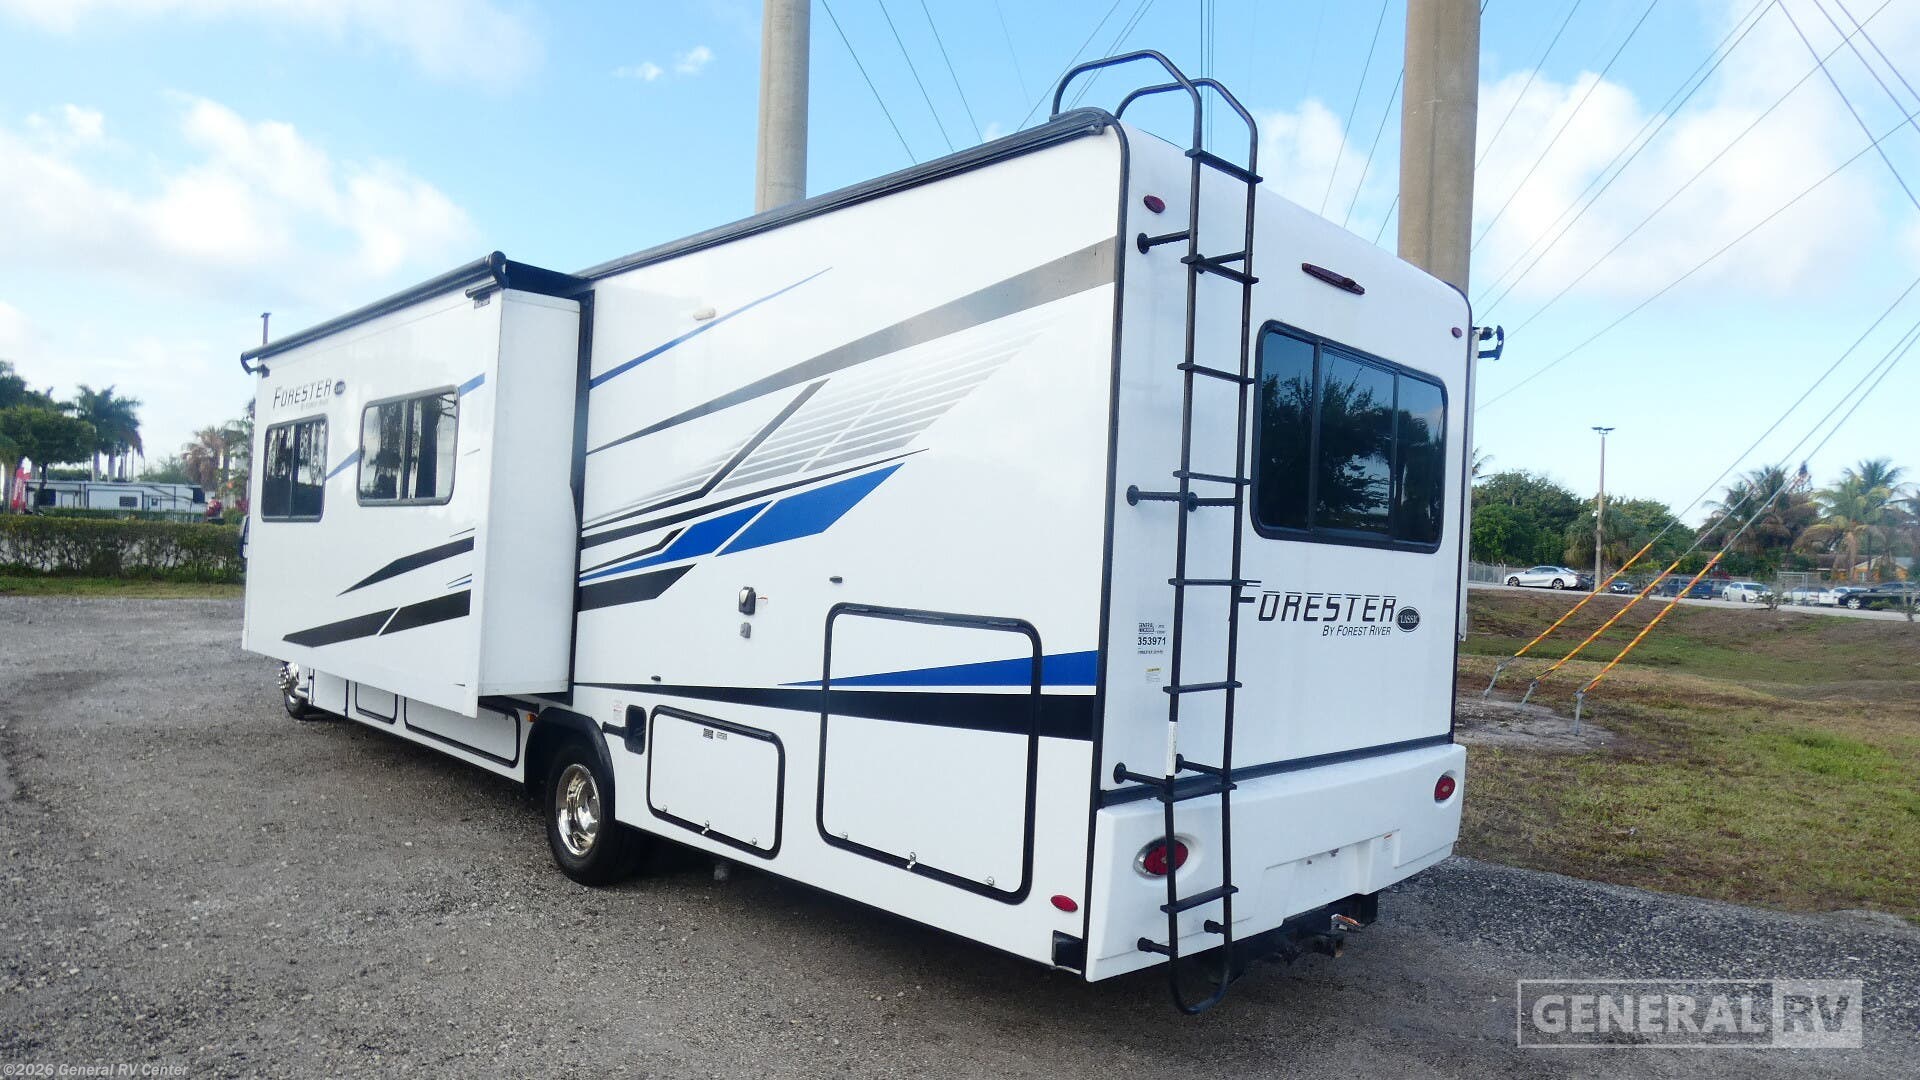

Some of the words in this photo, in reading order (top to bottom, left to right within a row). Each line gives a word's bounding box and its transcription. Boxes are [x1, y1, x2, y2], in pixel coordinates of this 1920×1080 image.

[273, 379, 332, 409] FORESTER
[1336, 625, 1368, 637] FOREST
[1369, 625, 1392, 637] RIVER
[1137, 636, 1166, 646] 353971
